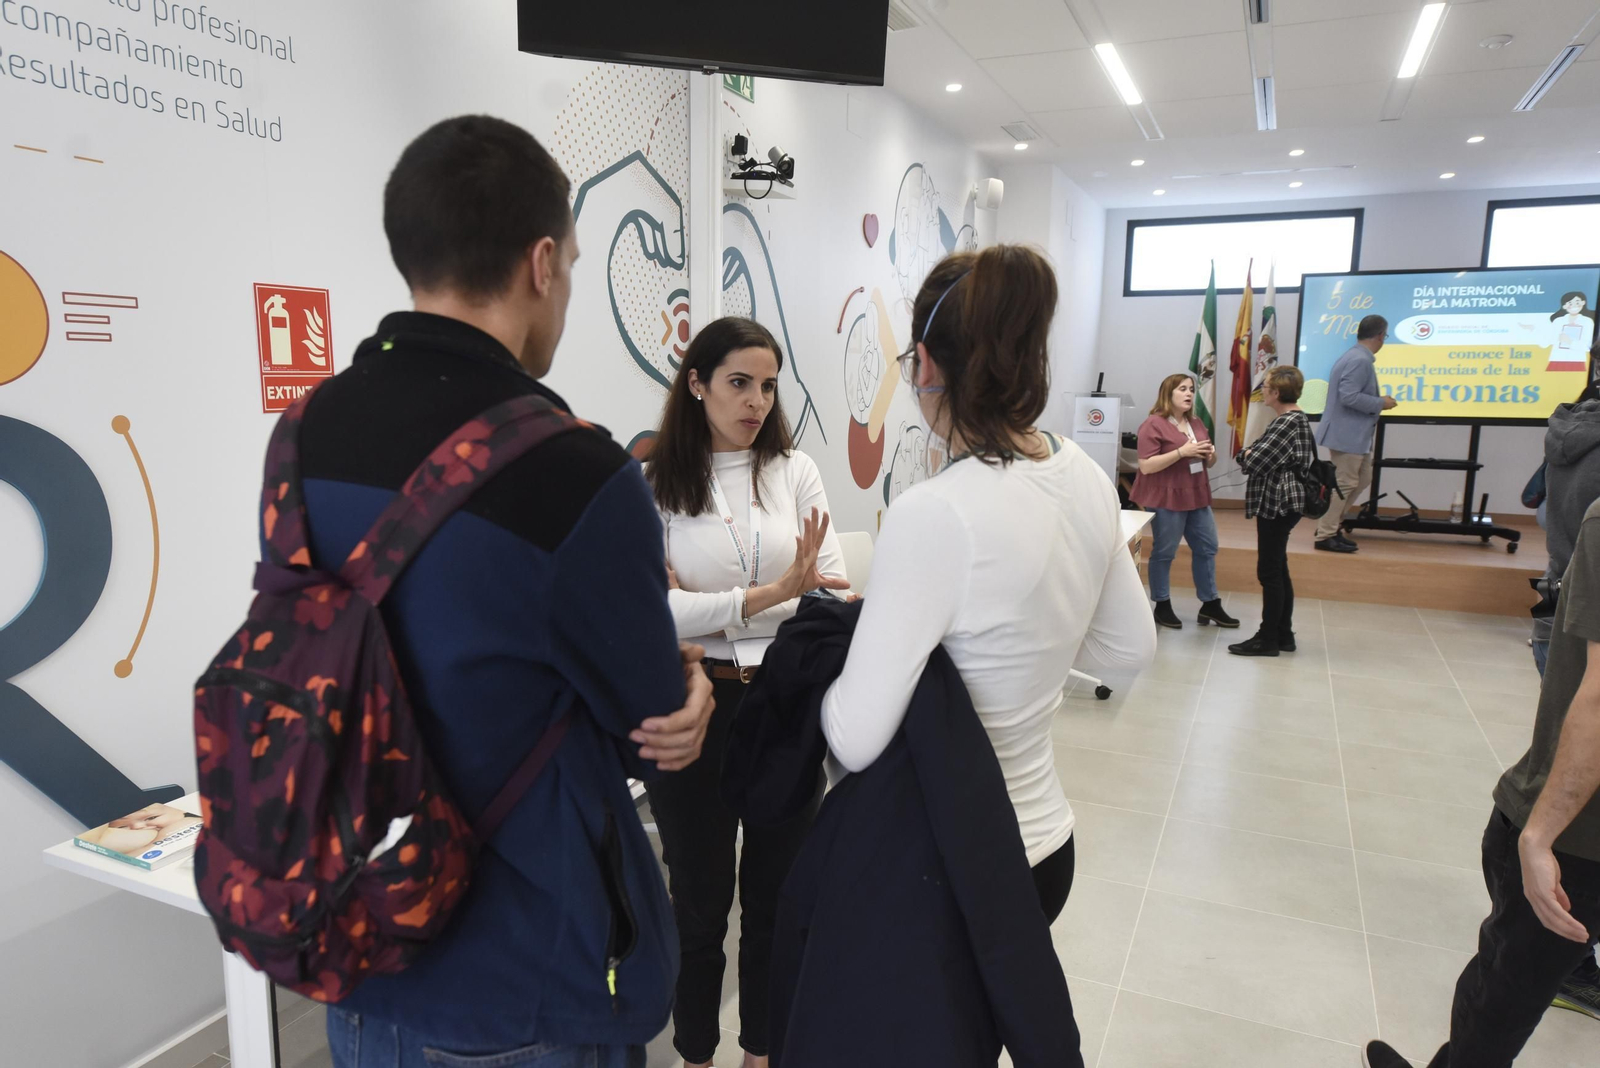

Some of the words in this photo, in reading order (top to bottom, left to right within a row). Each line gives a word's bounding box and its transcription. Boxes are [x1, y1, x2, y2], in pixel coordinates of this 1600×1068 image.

[153, 0, 296, 63] profesional
[0, 46, 164, 113] esultados
[174, 96, 205, 123] en
[215, 100, 282, 142] Salud
[1413, 285, 1435, 297] DÍA
[1437, 284, 1545, 297] INTERNACIONAL
[1349, 291, 1374, 310] de
[1412, 299, 1430, 309] DE
[1432, 299, 1448, 309] LA
[1450, 297, 1517, 308] MATRONA
[1448, 350, 1504, 360] conoce
[1509, 347, 1532, 360] las
[1375, 364, 1478, 378] competencias
[1482, 364, 1502, 376] de
[1507, 364, 1530, 376] las
